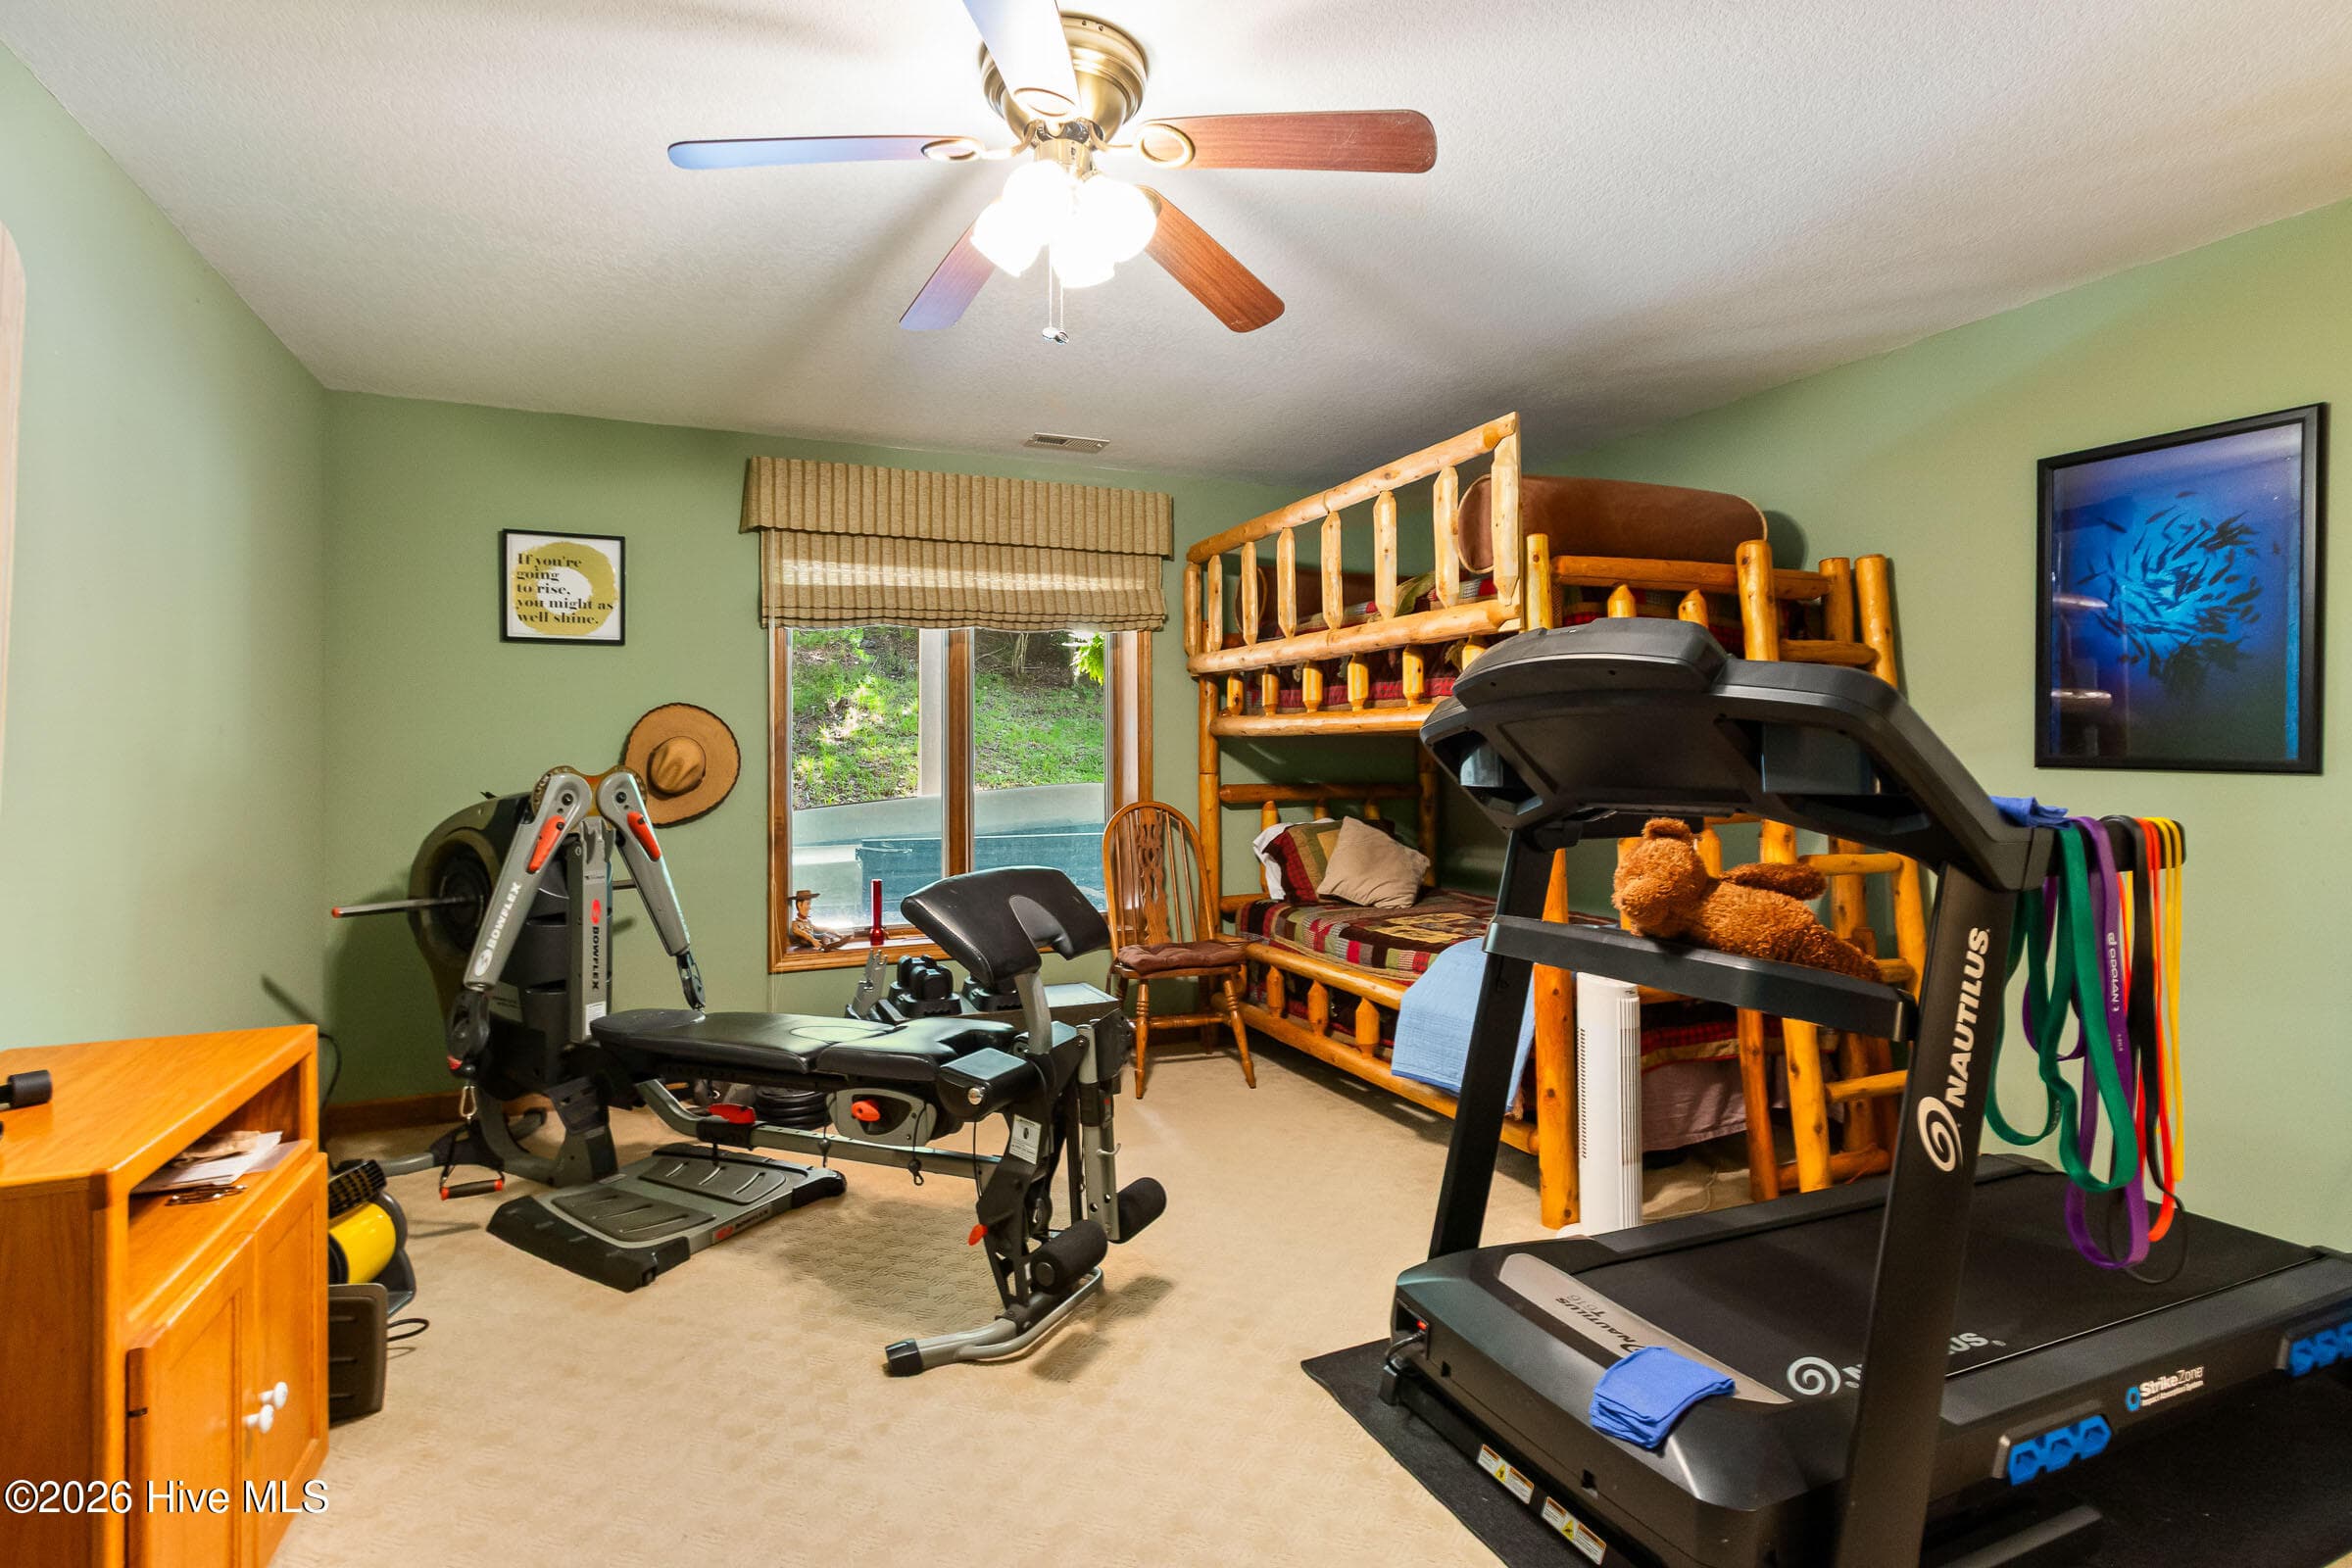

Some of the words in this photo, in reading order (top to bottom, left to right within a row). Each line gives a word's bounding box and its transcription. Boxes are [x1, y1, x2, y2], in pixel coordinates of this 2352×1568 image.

[517, 553, 533, 565] If
[534, 556, 582, 571] you're
[516, 568, 560, 582] going
[516, 583, 532, 593] to
[516, 599, 544, 610] you
[549, 598, 592, 610] might
[598, 602, 613, 611] as
[517, 612, 548, 622] well
[554, 612, 599, 625] shine.
[485, 881, 522, 950] BOWFLEX
[1944, 927, 1989, 1108] NAUTILUS
[1555, 1298, 1638, 1344] NAUTILUS
